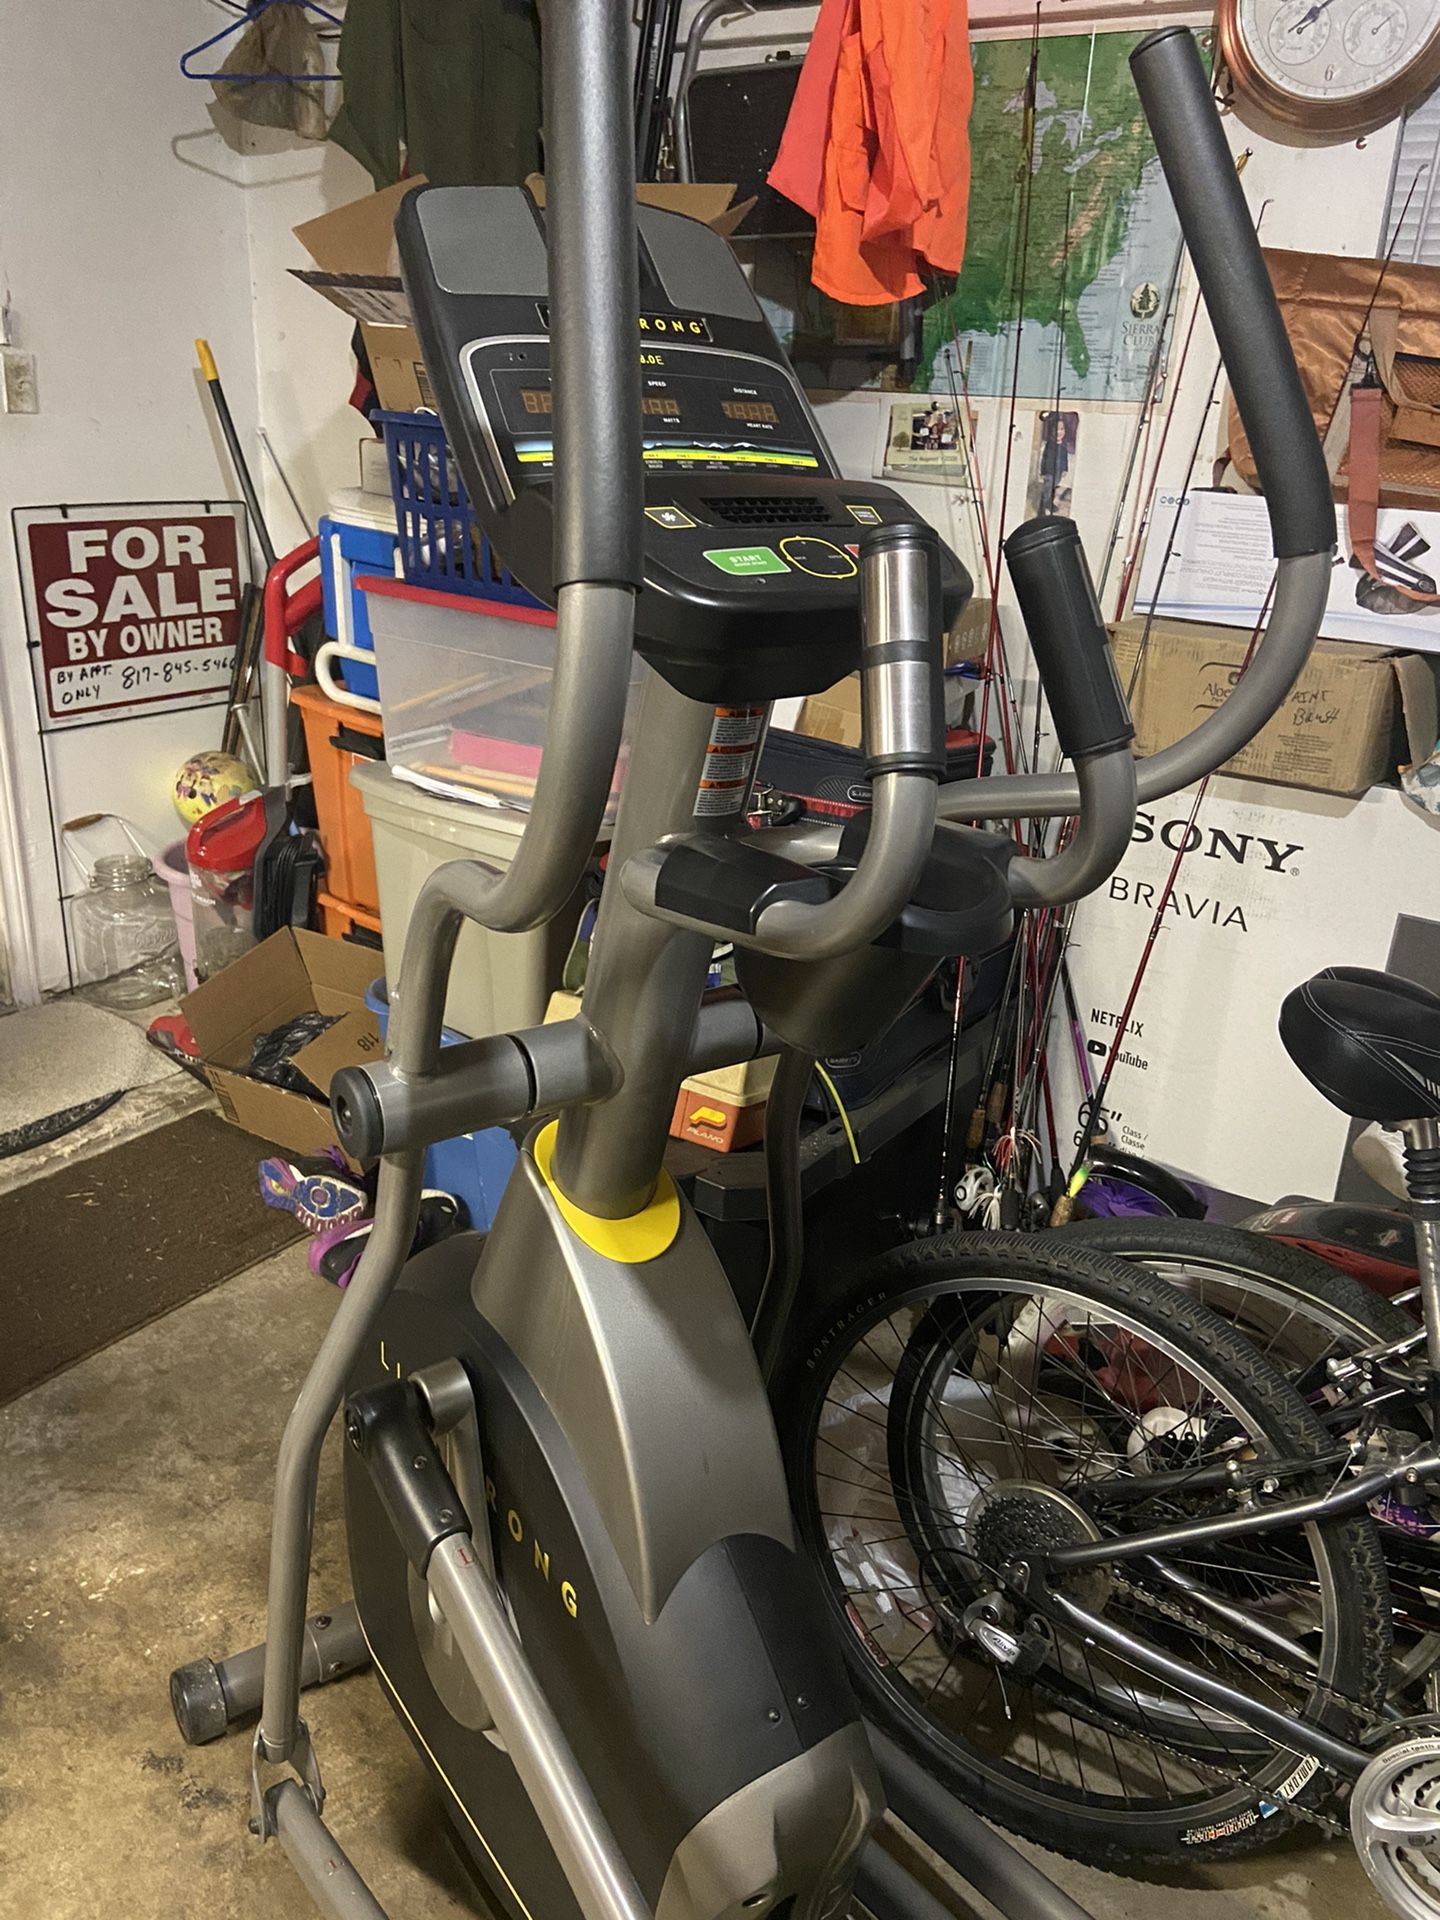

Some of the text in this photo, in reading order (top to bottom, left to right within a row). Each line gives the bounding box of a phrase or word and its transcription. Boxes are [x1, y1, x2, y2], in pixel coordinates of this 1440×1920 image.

[67, 525, 207, 574] FOR
[728, 554, 762, 562] START
[44, 567, 236, 628] SALE
[67, 616, 224, 661] BY OWNER
[57, 670, 73, 684] BY
[62, 684, 101, 705] ONLY
[1281, 689, 1334, 707] AINT
[1131, 811, 1304, 873] SONY
[1109, 876, 1248, 932] BRAVIA
[686, 1126, 725, 1144] PLANO
[1121, 1135, 1146, 1150] Classe
[1122, 1125, 1142, 1139] Class
[806, 1291, 887, 1369] BONTRAGER
[1382, 1743, 1435, 1764] Special teeth
